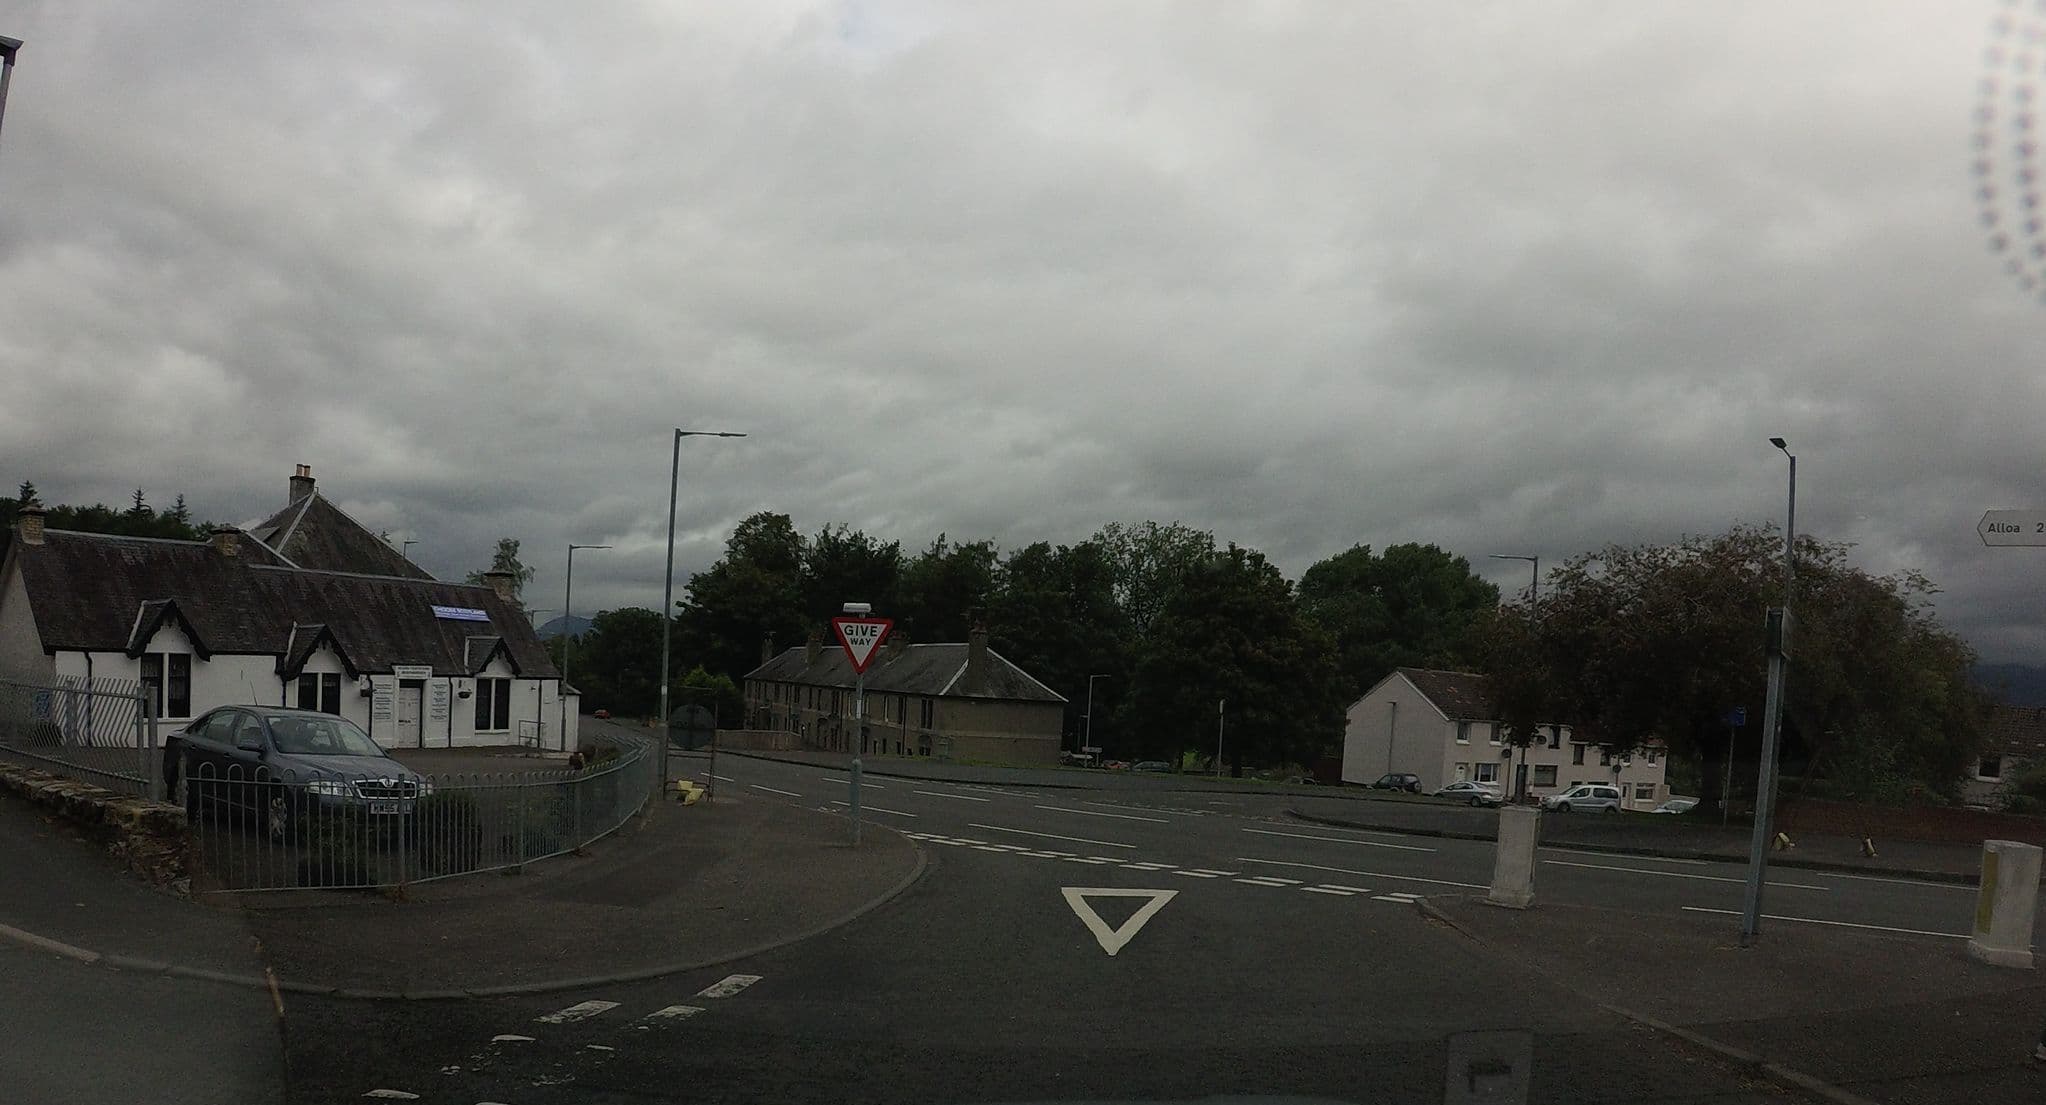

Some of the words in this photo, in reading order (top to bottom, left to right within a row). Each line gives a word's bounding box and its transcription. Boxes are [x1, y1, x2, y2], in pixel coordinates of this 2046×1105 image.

[1987, 522, 2020, 533] Alloa
[844, 624, 877, 637] GIVE
[850, 637, 871, 646] WAY
